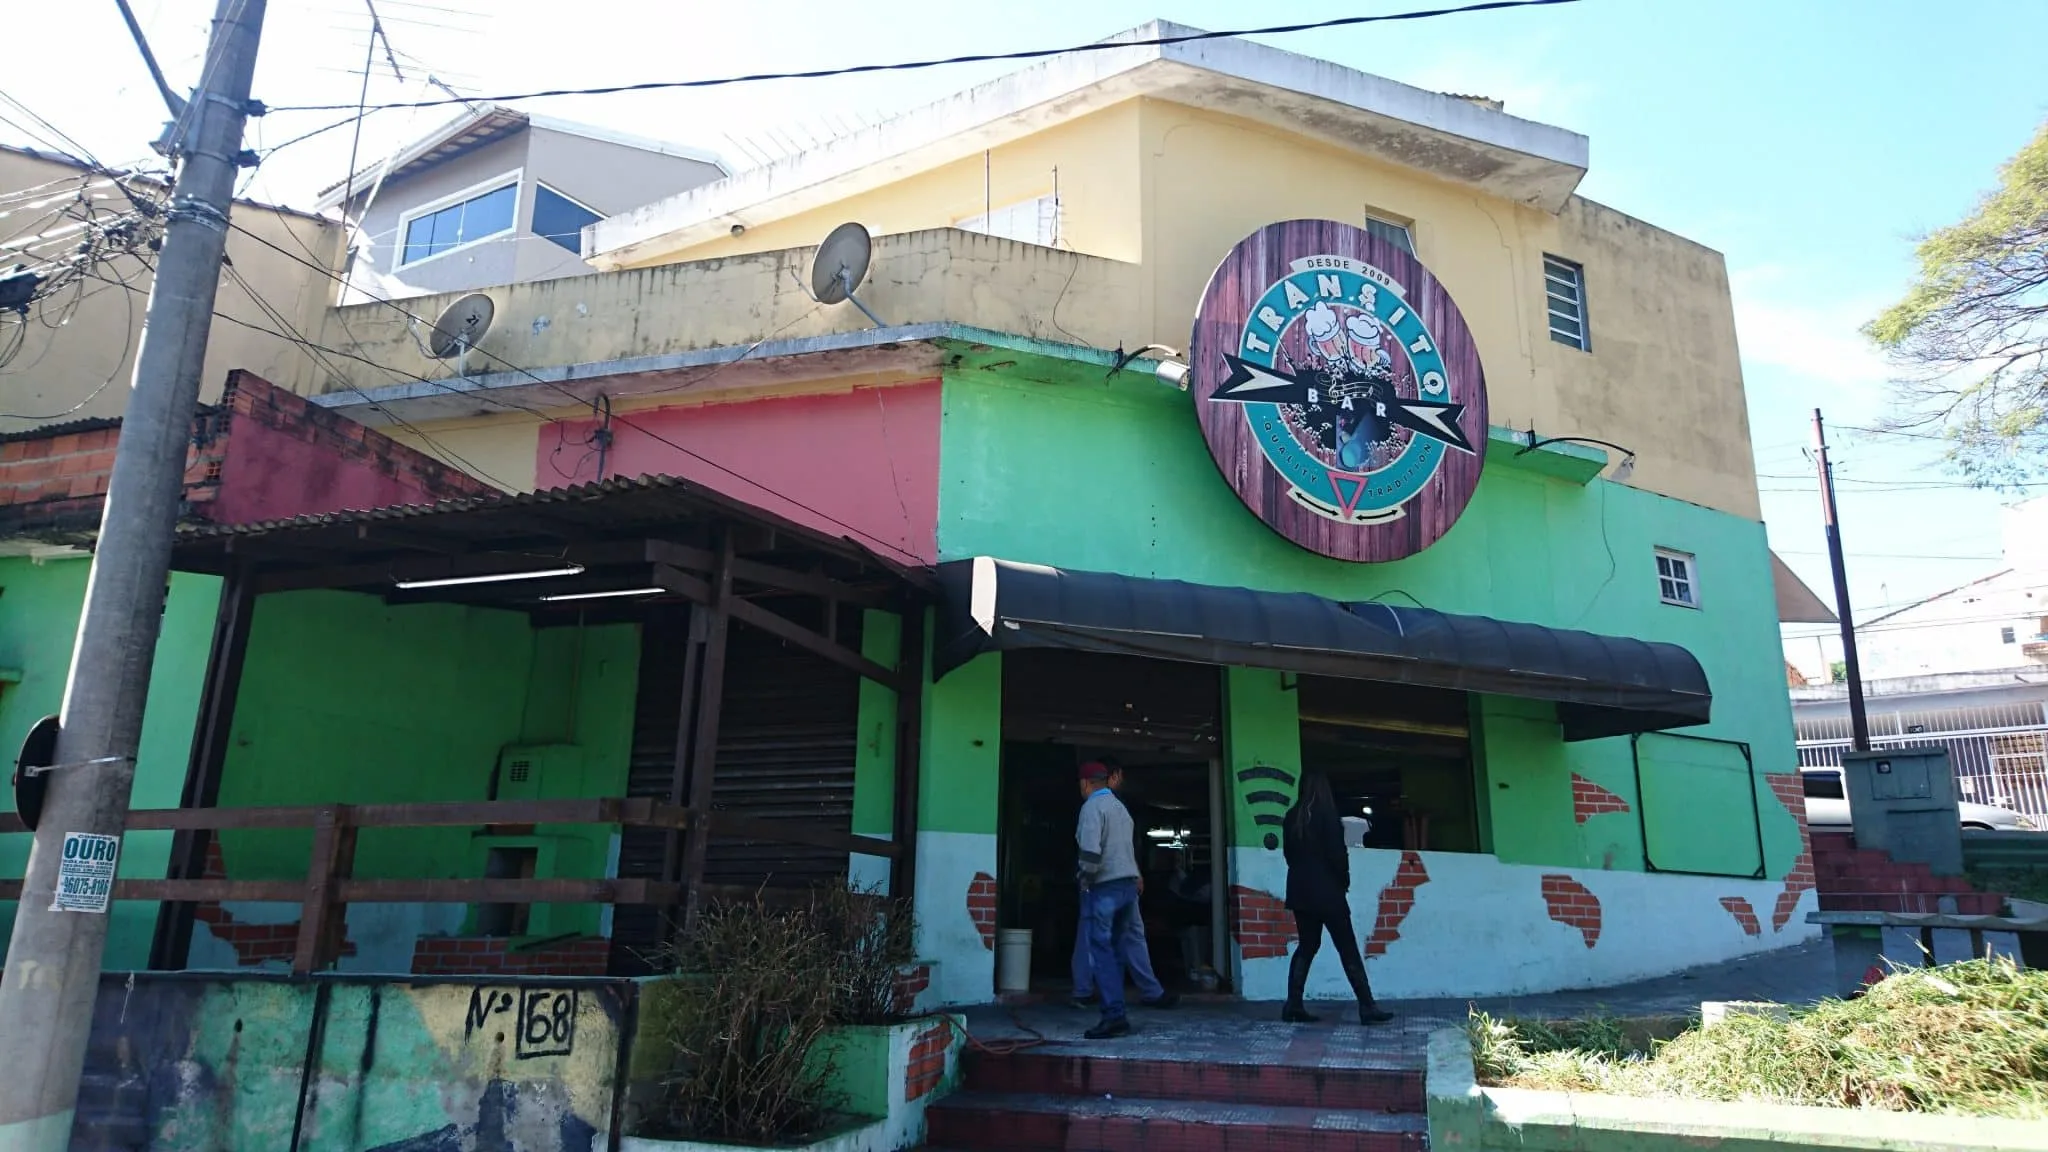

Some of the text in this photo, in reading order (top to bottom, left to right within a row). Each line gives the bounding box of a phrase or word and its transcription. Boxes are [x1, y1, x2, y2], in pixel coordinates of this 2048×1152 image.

[1307, 258, 1391, 286] DESDE 2009
[1246, 274, 1445, 396] TRANSITO
[1308, 388, 1387, 418] BAR
[1264, 422, 1317, 483] QUALITY
[1368, 444, 1432, 497] TRADITION
[64, 838, 116, 861] OURO
[525, 992, 571, 1044] 68
